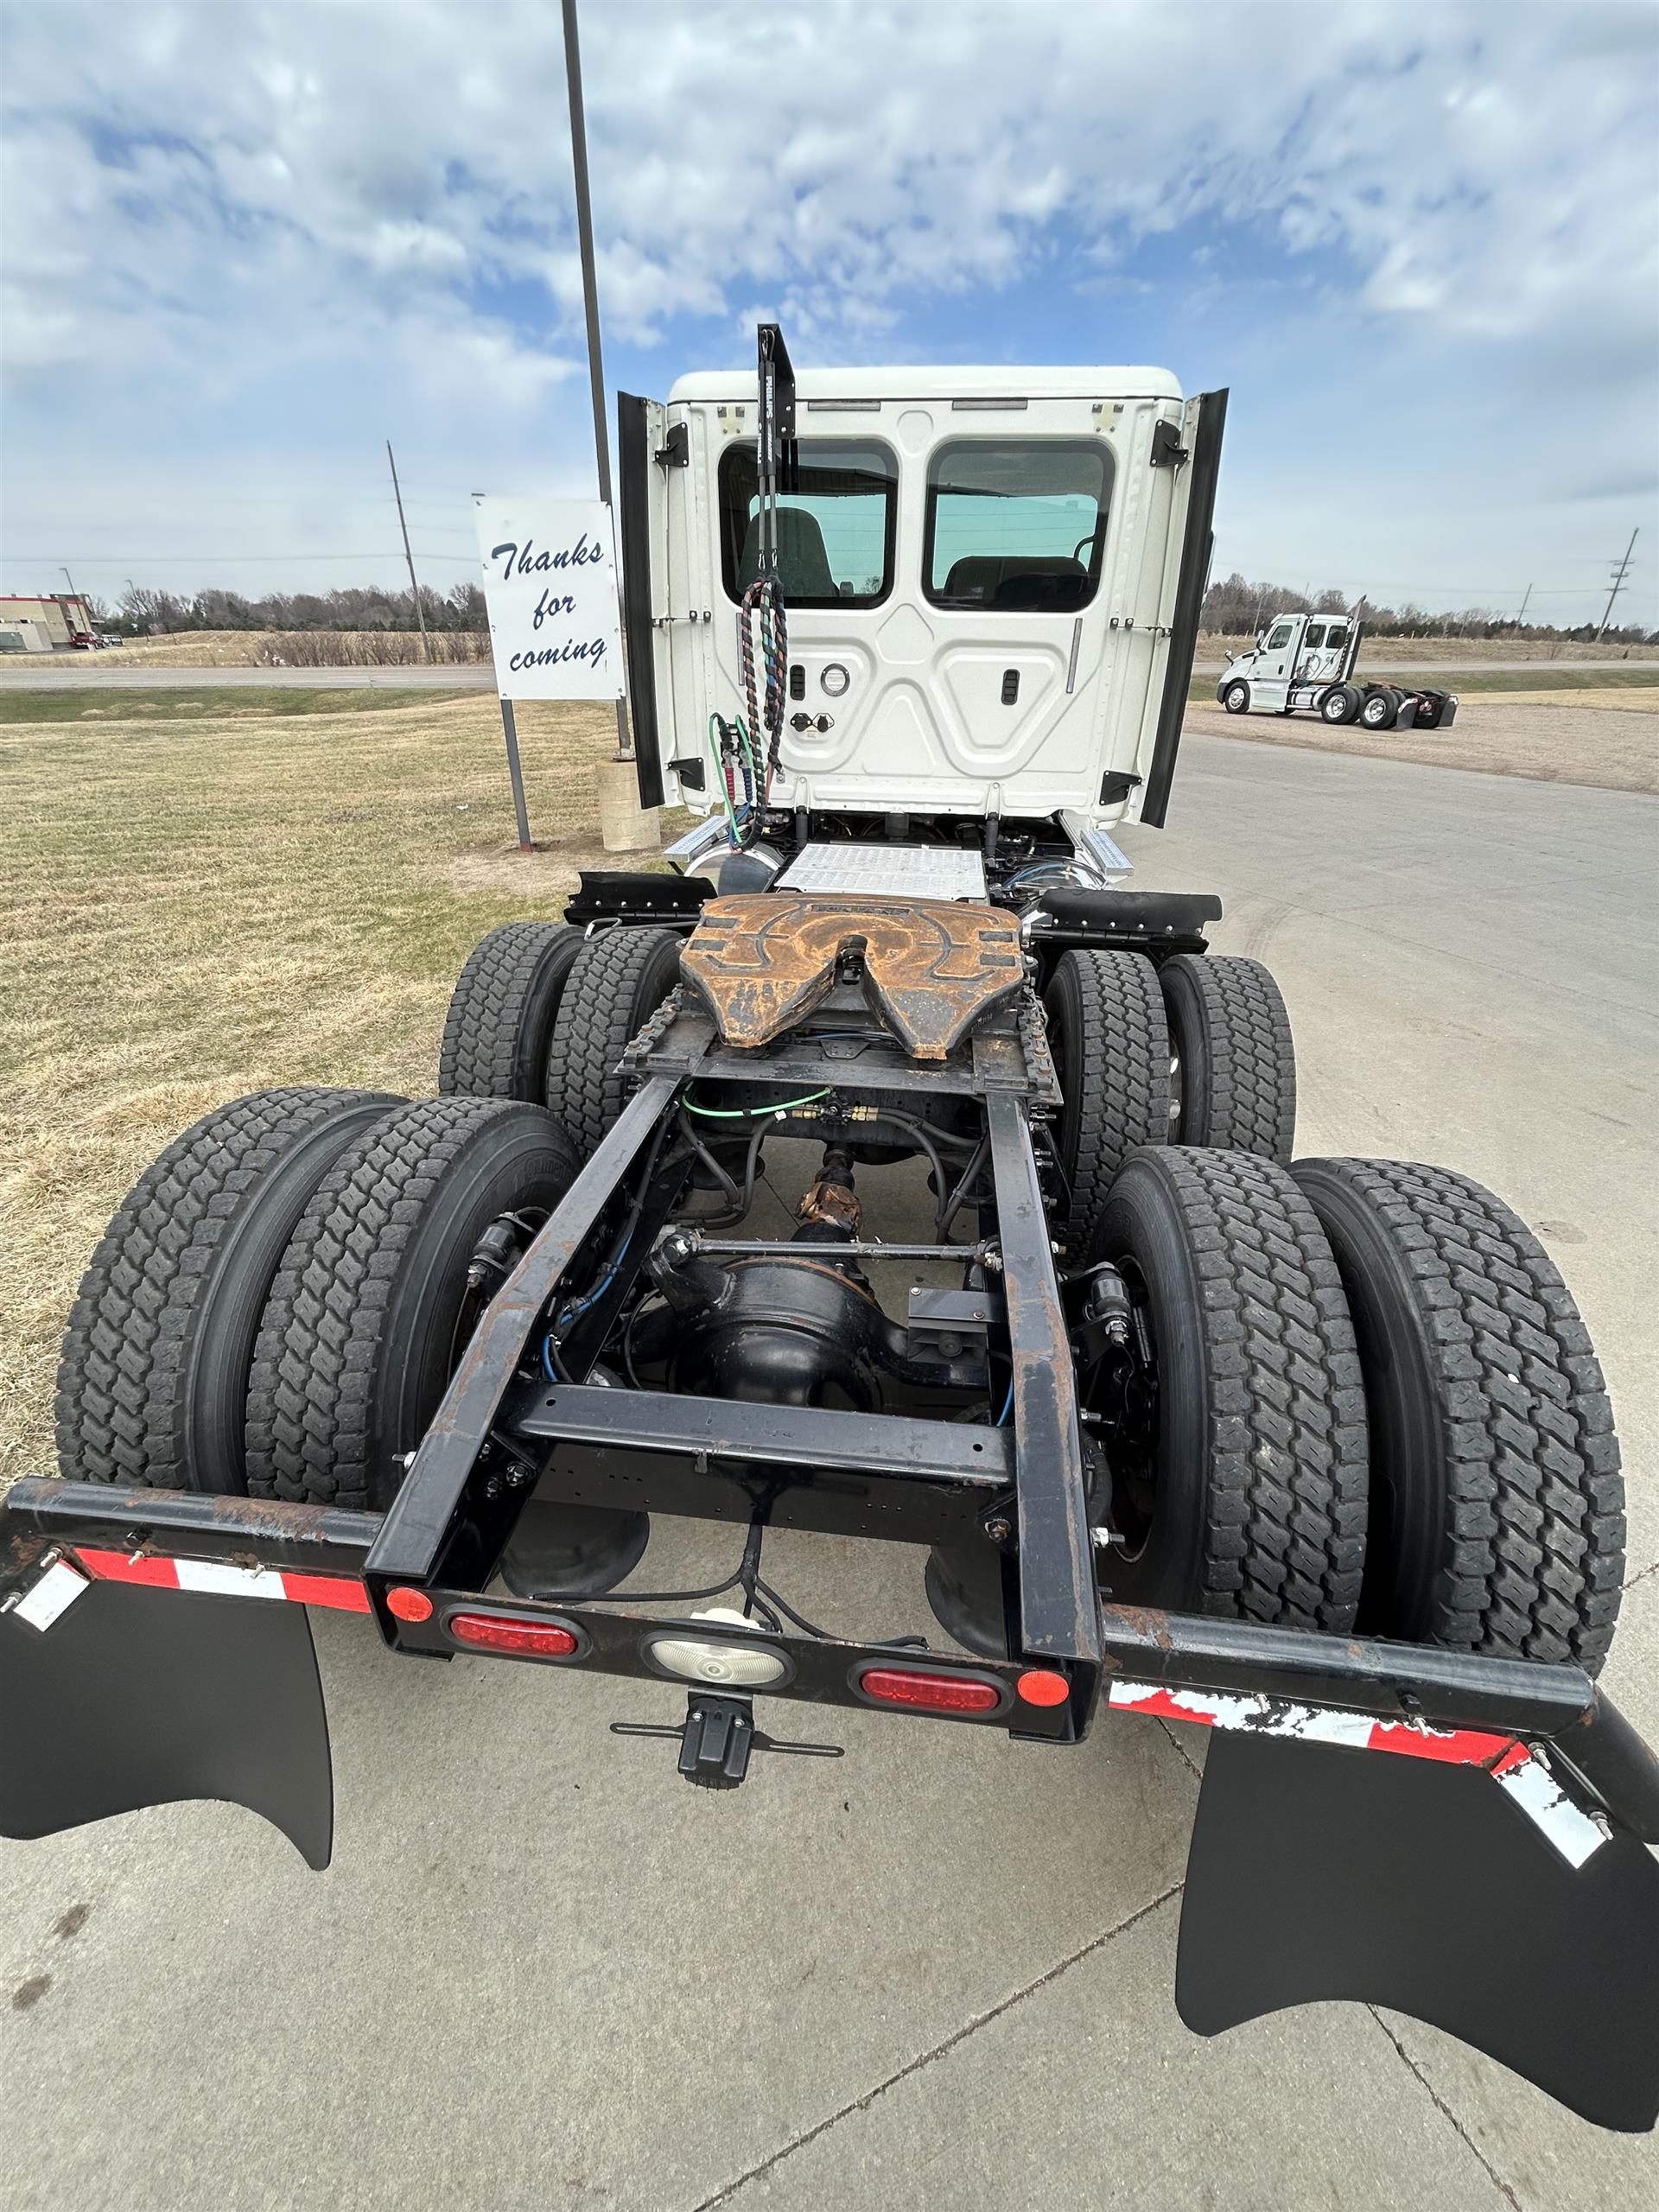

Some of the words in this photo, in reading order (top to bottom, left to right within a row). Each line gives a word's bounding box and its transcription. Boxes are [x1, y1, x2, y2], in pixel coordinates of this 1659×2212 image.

[492, 532, 604, 580] Thanks
[533, 588, 576, 630] for
[510, 638, 607, 671] coming
